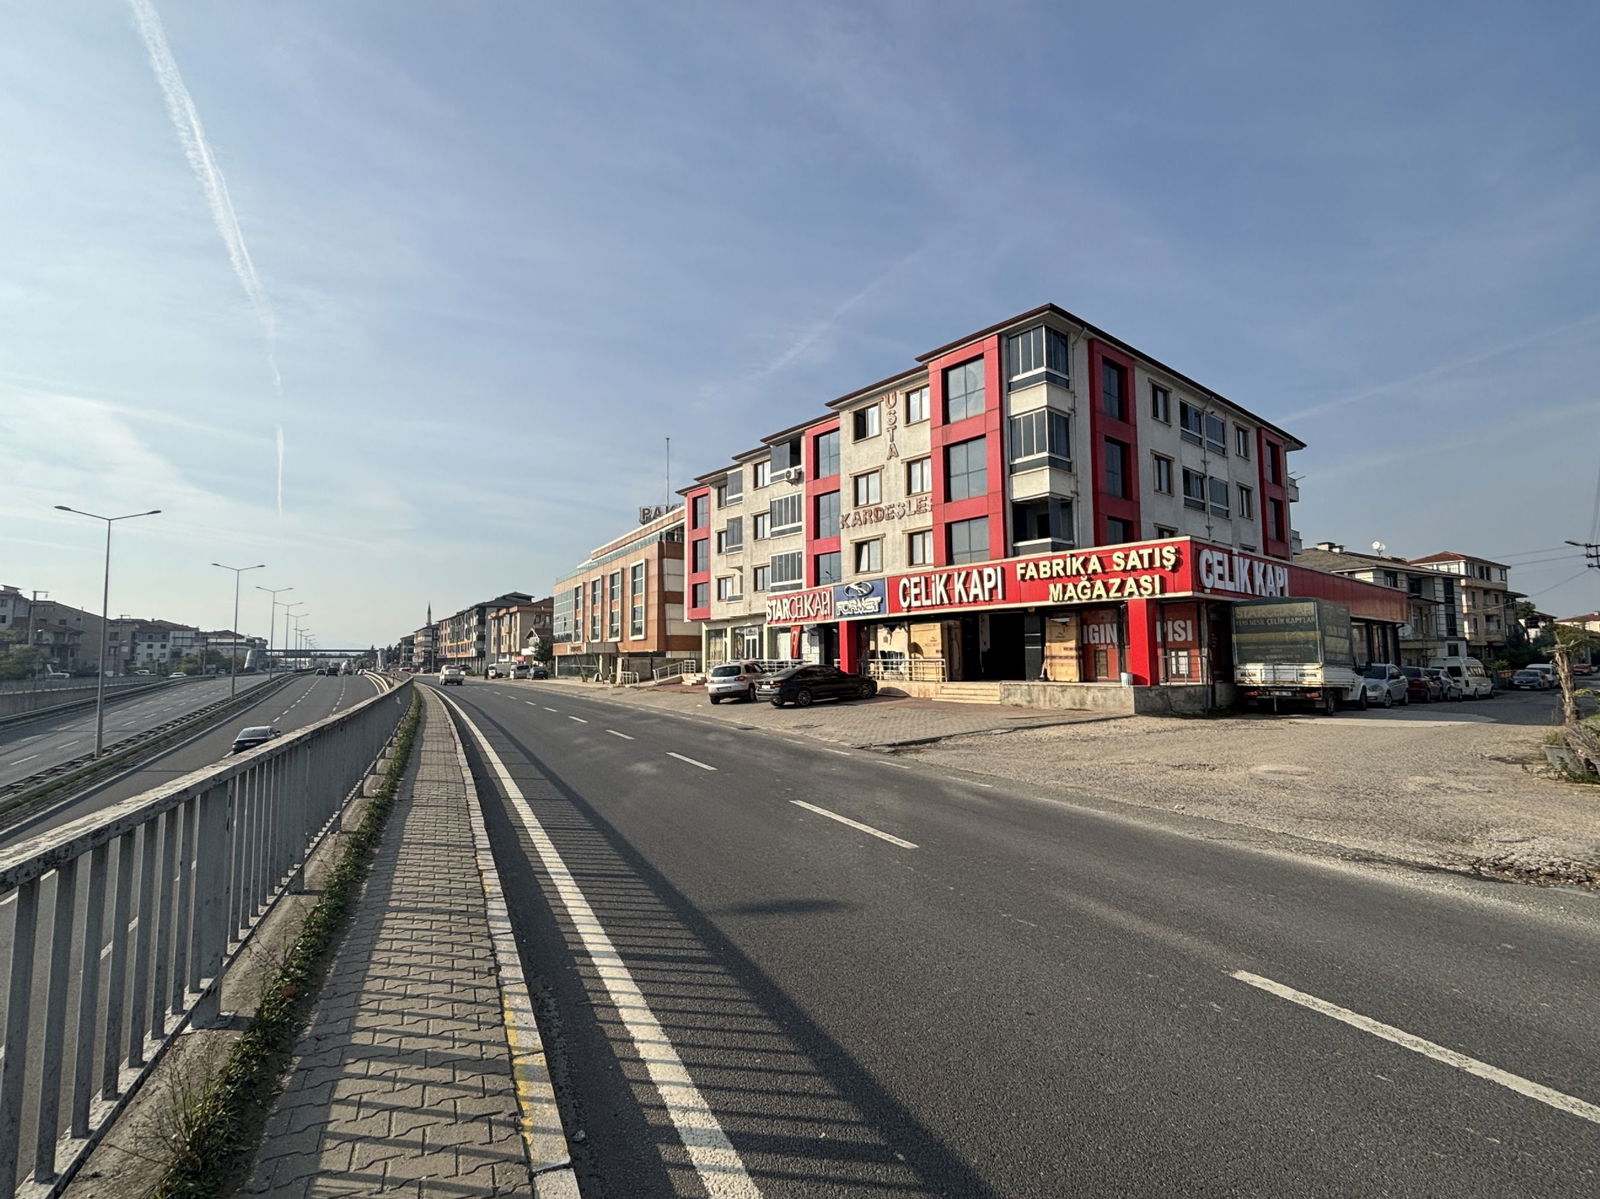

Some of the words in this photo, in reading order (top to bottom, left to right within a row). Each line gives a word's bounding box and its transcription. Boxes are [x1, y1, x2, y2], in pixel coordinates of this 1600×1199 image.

[884, 391, 899, 460] USTA
[840, 496, 933, 529] KARDEŞLE
[1016, 554, 1103, 581] FABRİKA
[1112, 546, 1177, 571] SATIŞ
[1199, 547, 1253, 594] ÇELİK
[1252, 561, 1289, 597] KAPI
[898, 573, 949, 613] ÇELİK
[953, 566, 1003, 605] KAPI
[1049, 574, 1161, 603] MAĞAZASI
[836, 597, 882, 616] FORMET
